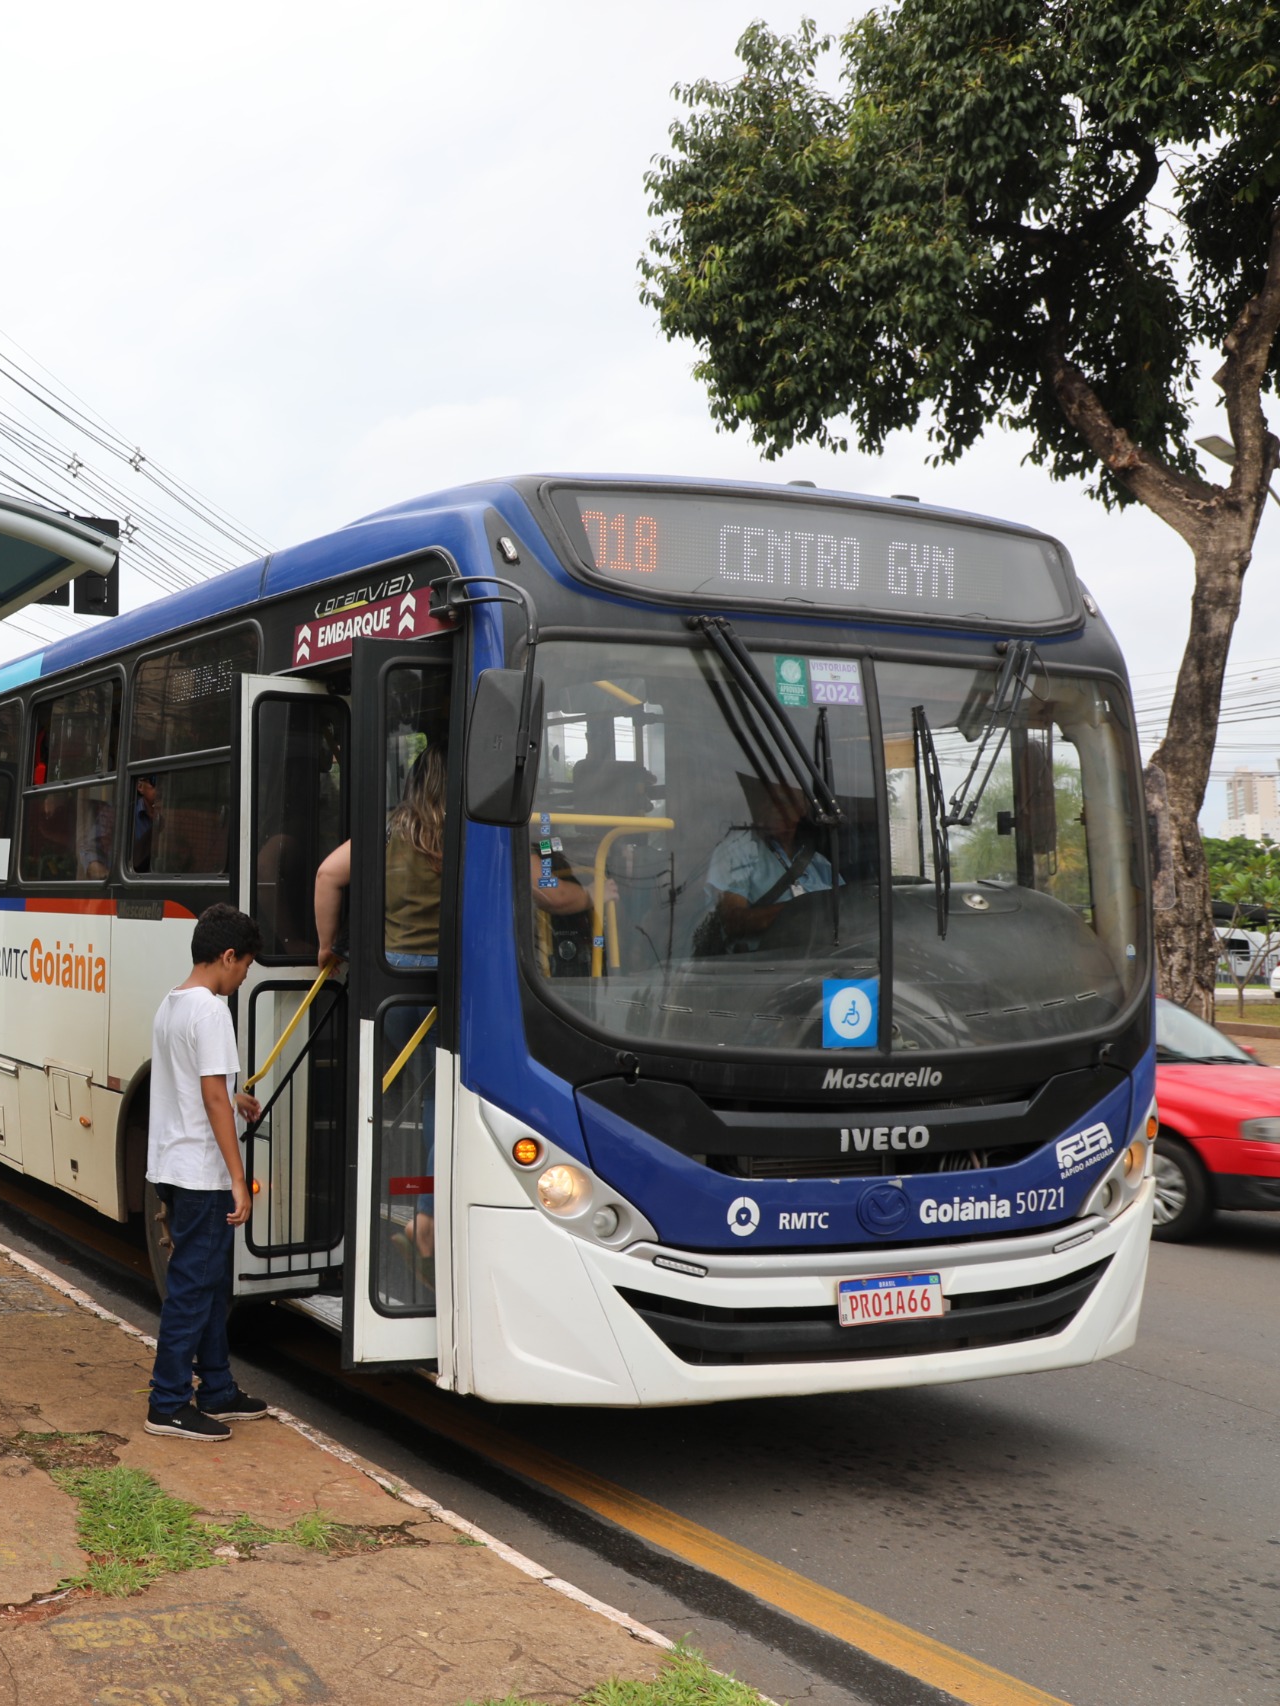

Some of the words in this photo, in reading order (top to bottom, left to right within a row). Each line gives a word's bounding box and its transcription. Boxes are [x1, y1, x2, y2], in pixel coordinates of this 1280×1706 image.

[719, 524, 860, 591] CENTRO
[888, 541, 955, 599] GYN
[317, 606, 392, 648] EMBARQUE
[811, 662, 857, 672] VISTORIADO
[815, 683, 859, 703] 2024
[821, 1067, 942, 1089] Mascarello
[840, 1125, 930, 1152] IVECO
[1085, 1147, 1115, 1168] ARAGUAIA
[1016, 1186, 1065, 1215] 50721
[778, 1212, 829, 1230] RMTC
[878, 1280, 896, 1288] BRASIL
